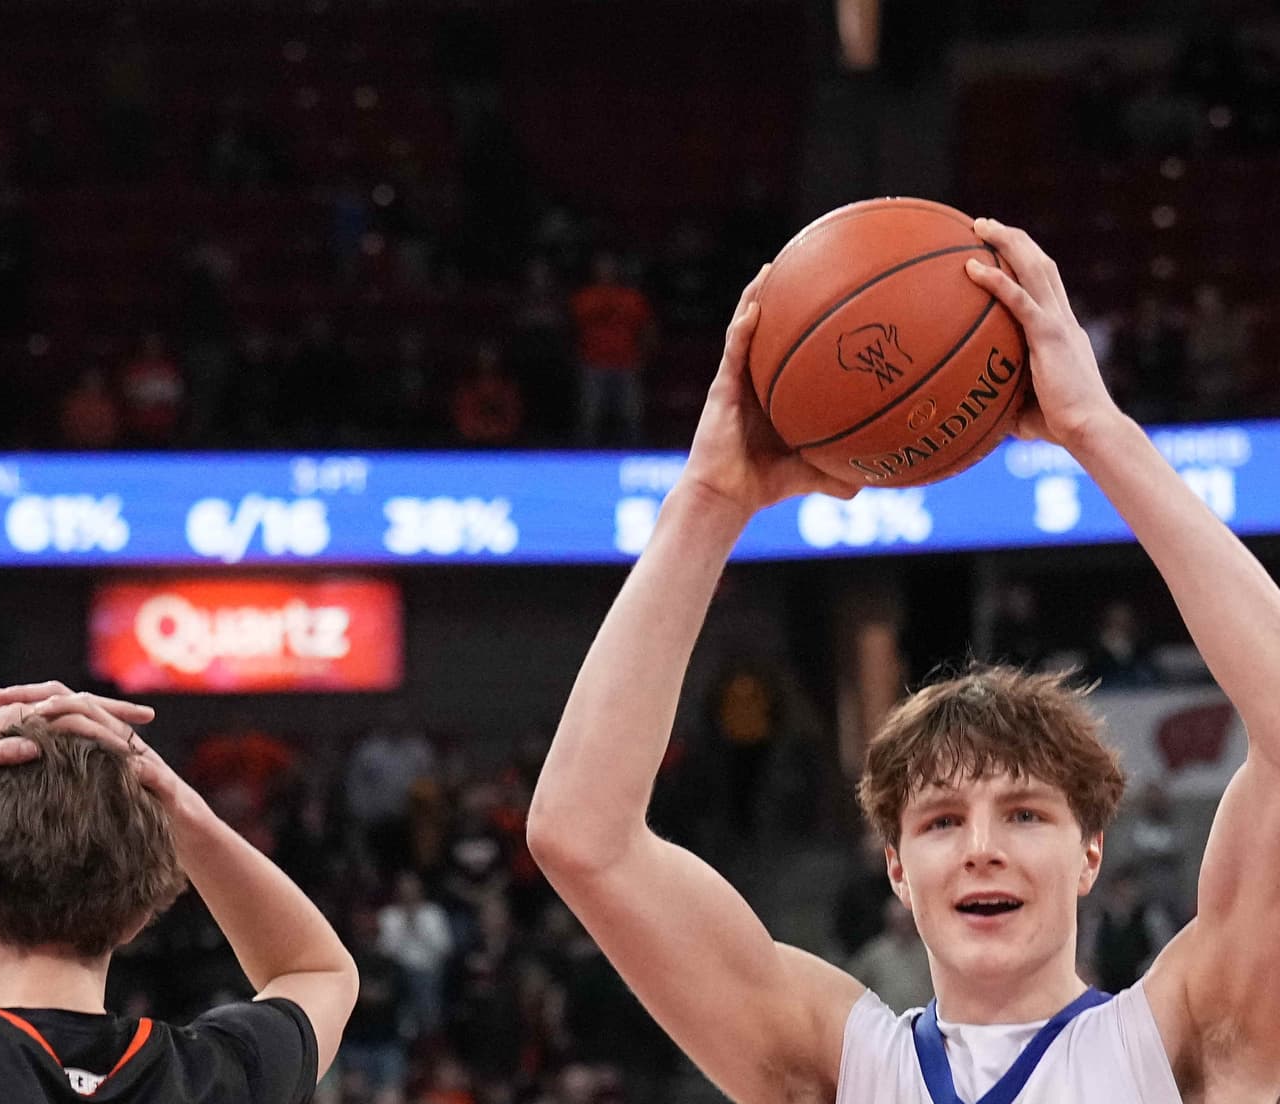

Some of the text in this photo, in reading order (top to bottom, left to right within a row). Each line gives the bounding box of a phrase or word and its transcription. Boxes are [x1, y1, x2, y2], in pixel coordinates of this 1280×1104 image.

[849, 346, 1016, 481] SPALDING
[5, 495, 129, 553] 61%
[186, 493, 328, 562] 6/16
[135, 595, 350, 673] Quartz
